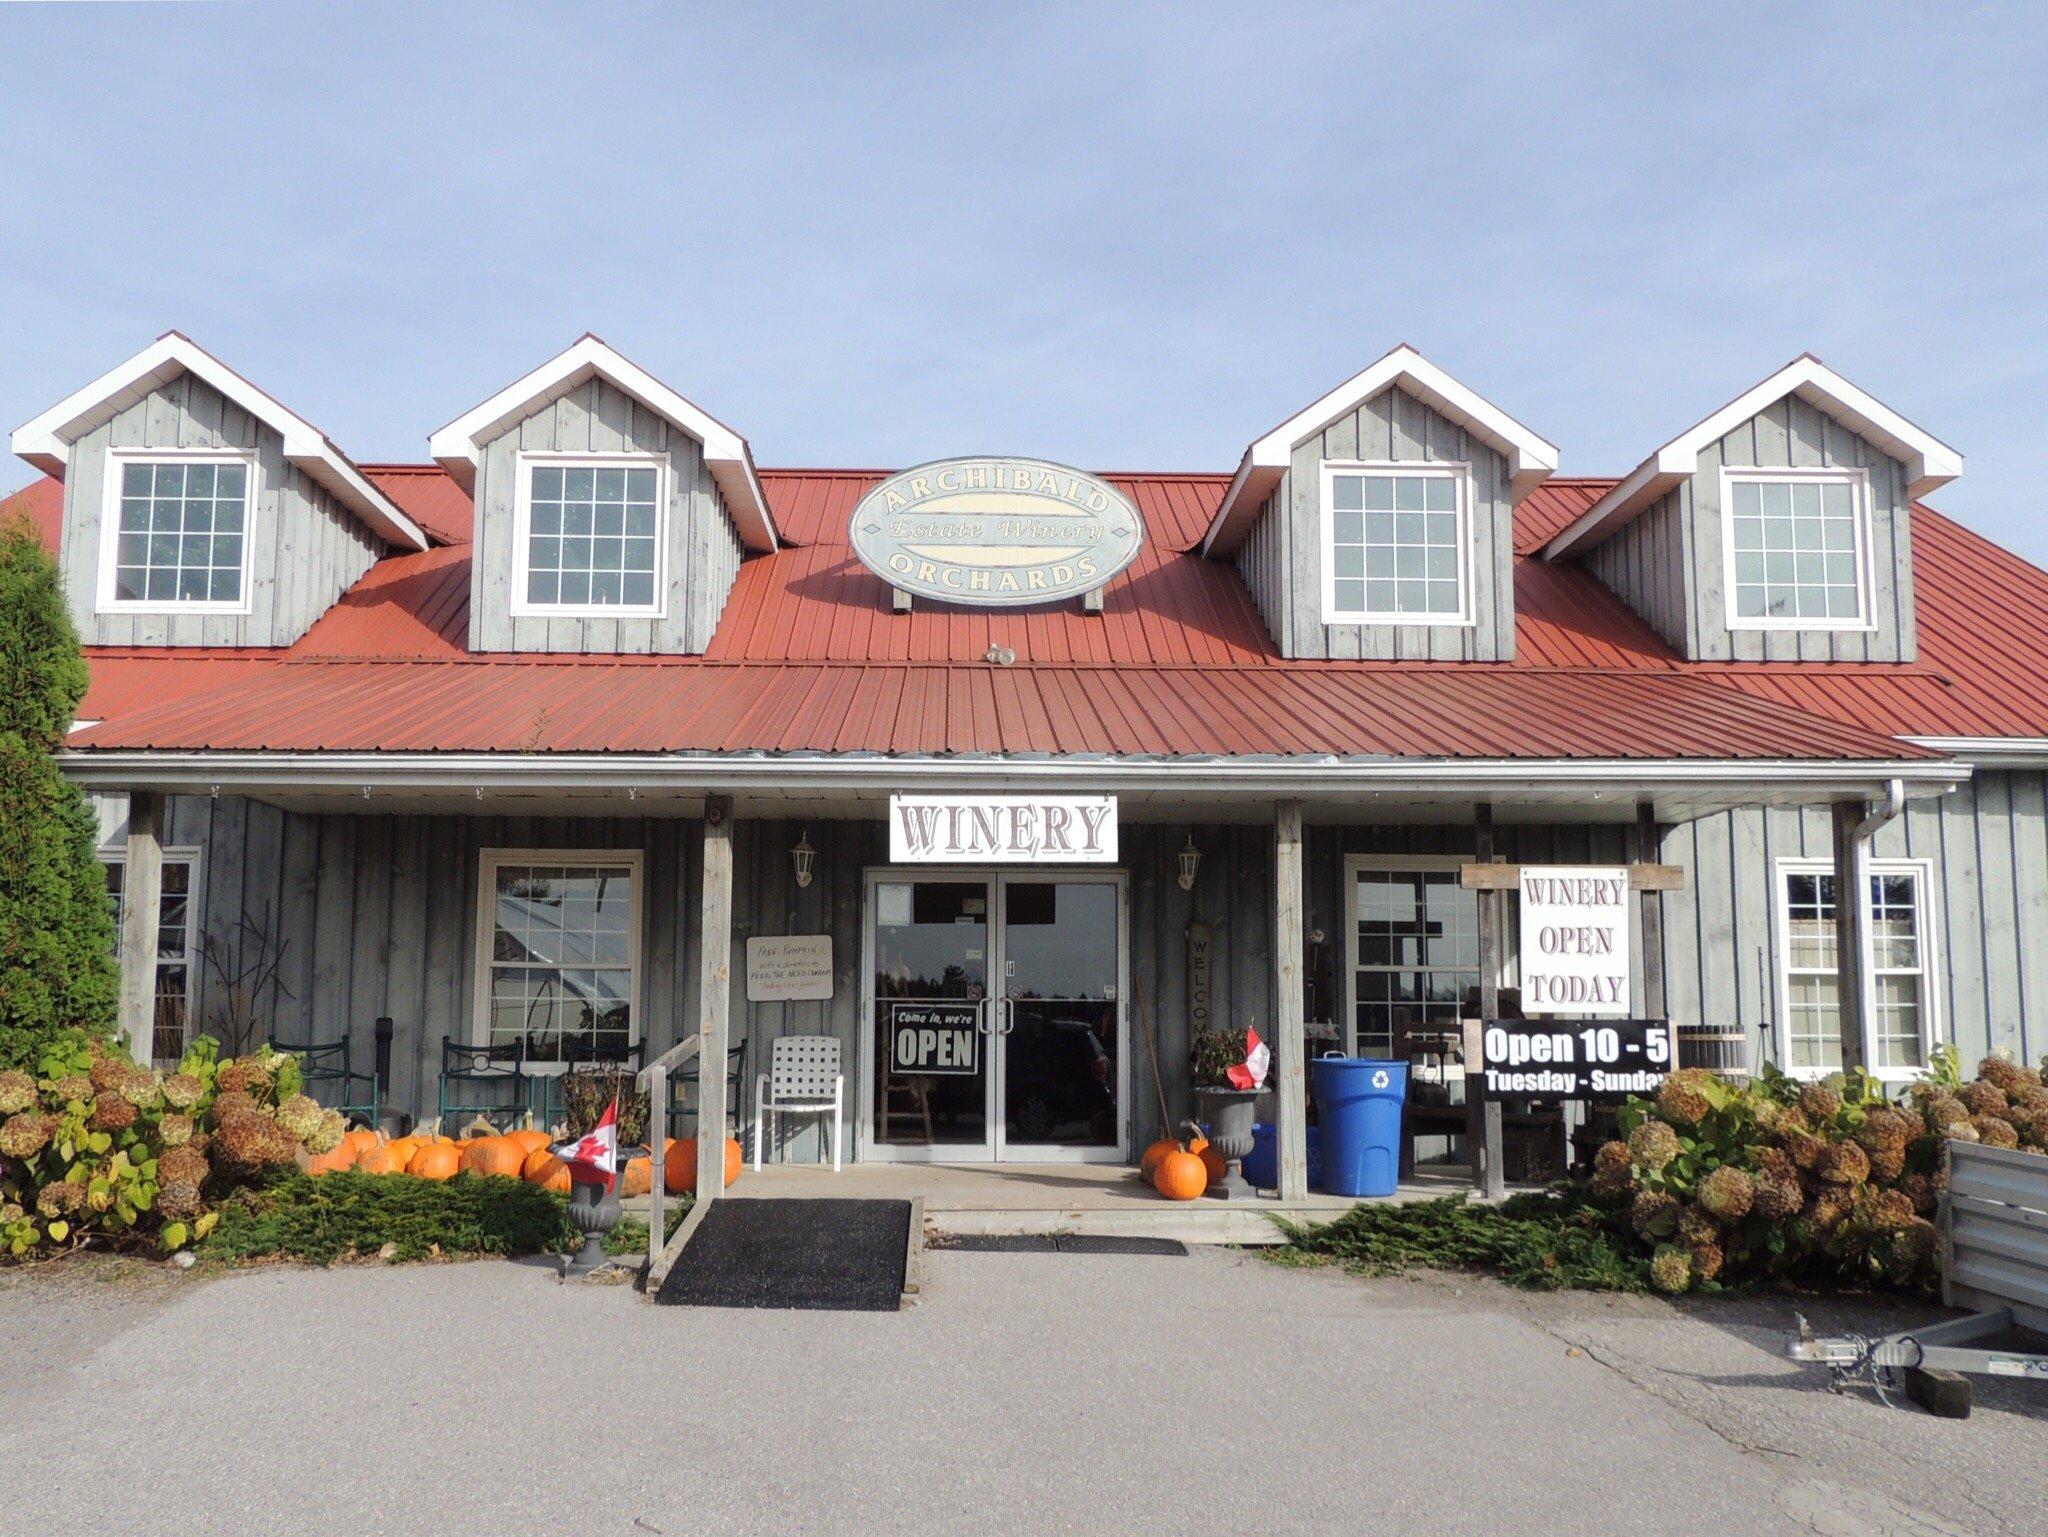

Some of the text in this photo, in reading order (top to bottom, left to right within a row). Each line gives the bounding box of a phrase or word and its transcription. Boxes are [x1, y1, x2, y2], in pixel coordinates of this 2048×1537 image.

[884, 466, 1110, 515] ARCHIBALD
[888, 519, 1104, 544] Estate Winery
[888, 553, 1098, 592] ORCHARDS
[897, 803, 1112, 858] WINERY
[1524, 878, 1626, 908] WINERY
[1540, 925, 1614, 957] OPEN
[1193, 941, 1207, 1036] WELCOM
[1529, 974, 1625, 1004] TODAY
[898, 1012, 973, 1025] Come in, we're
[897, 1028, 973, 1067] OPEN
[1485, 1028, 1669, 1066] Open 10 - 5
[1485, 1069, 1577, 1094] Tuesday
